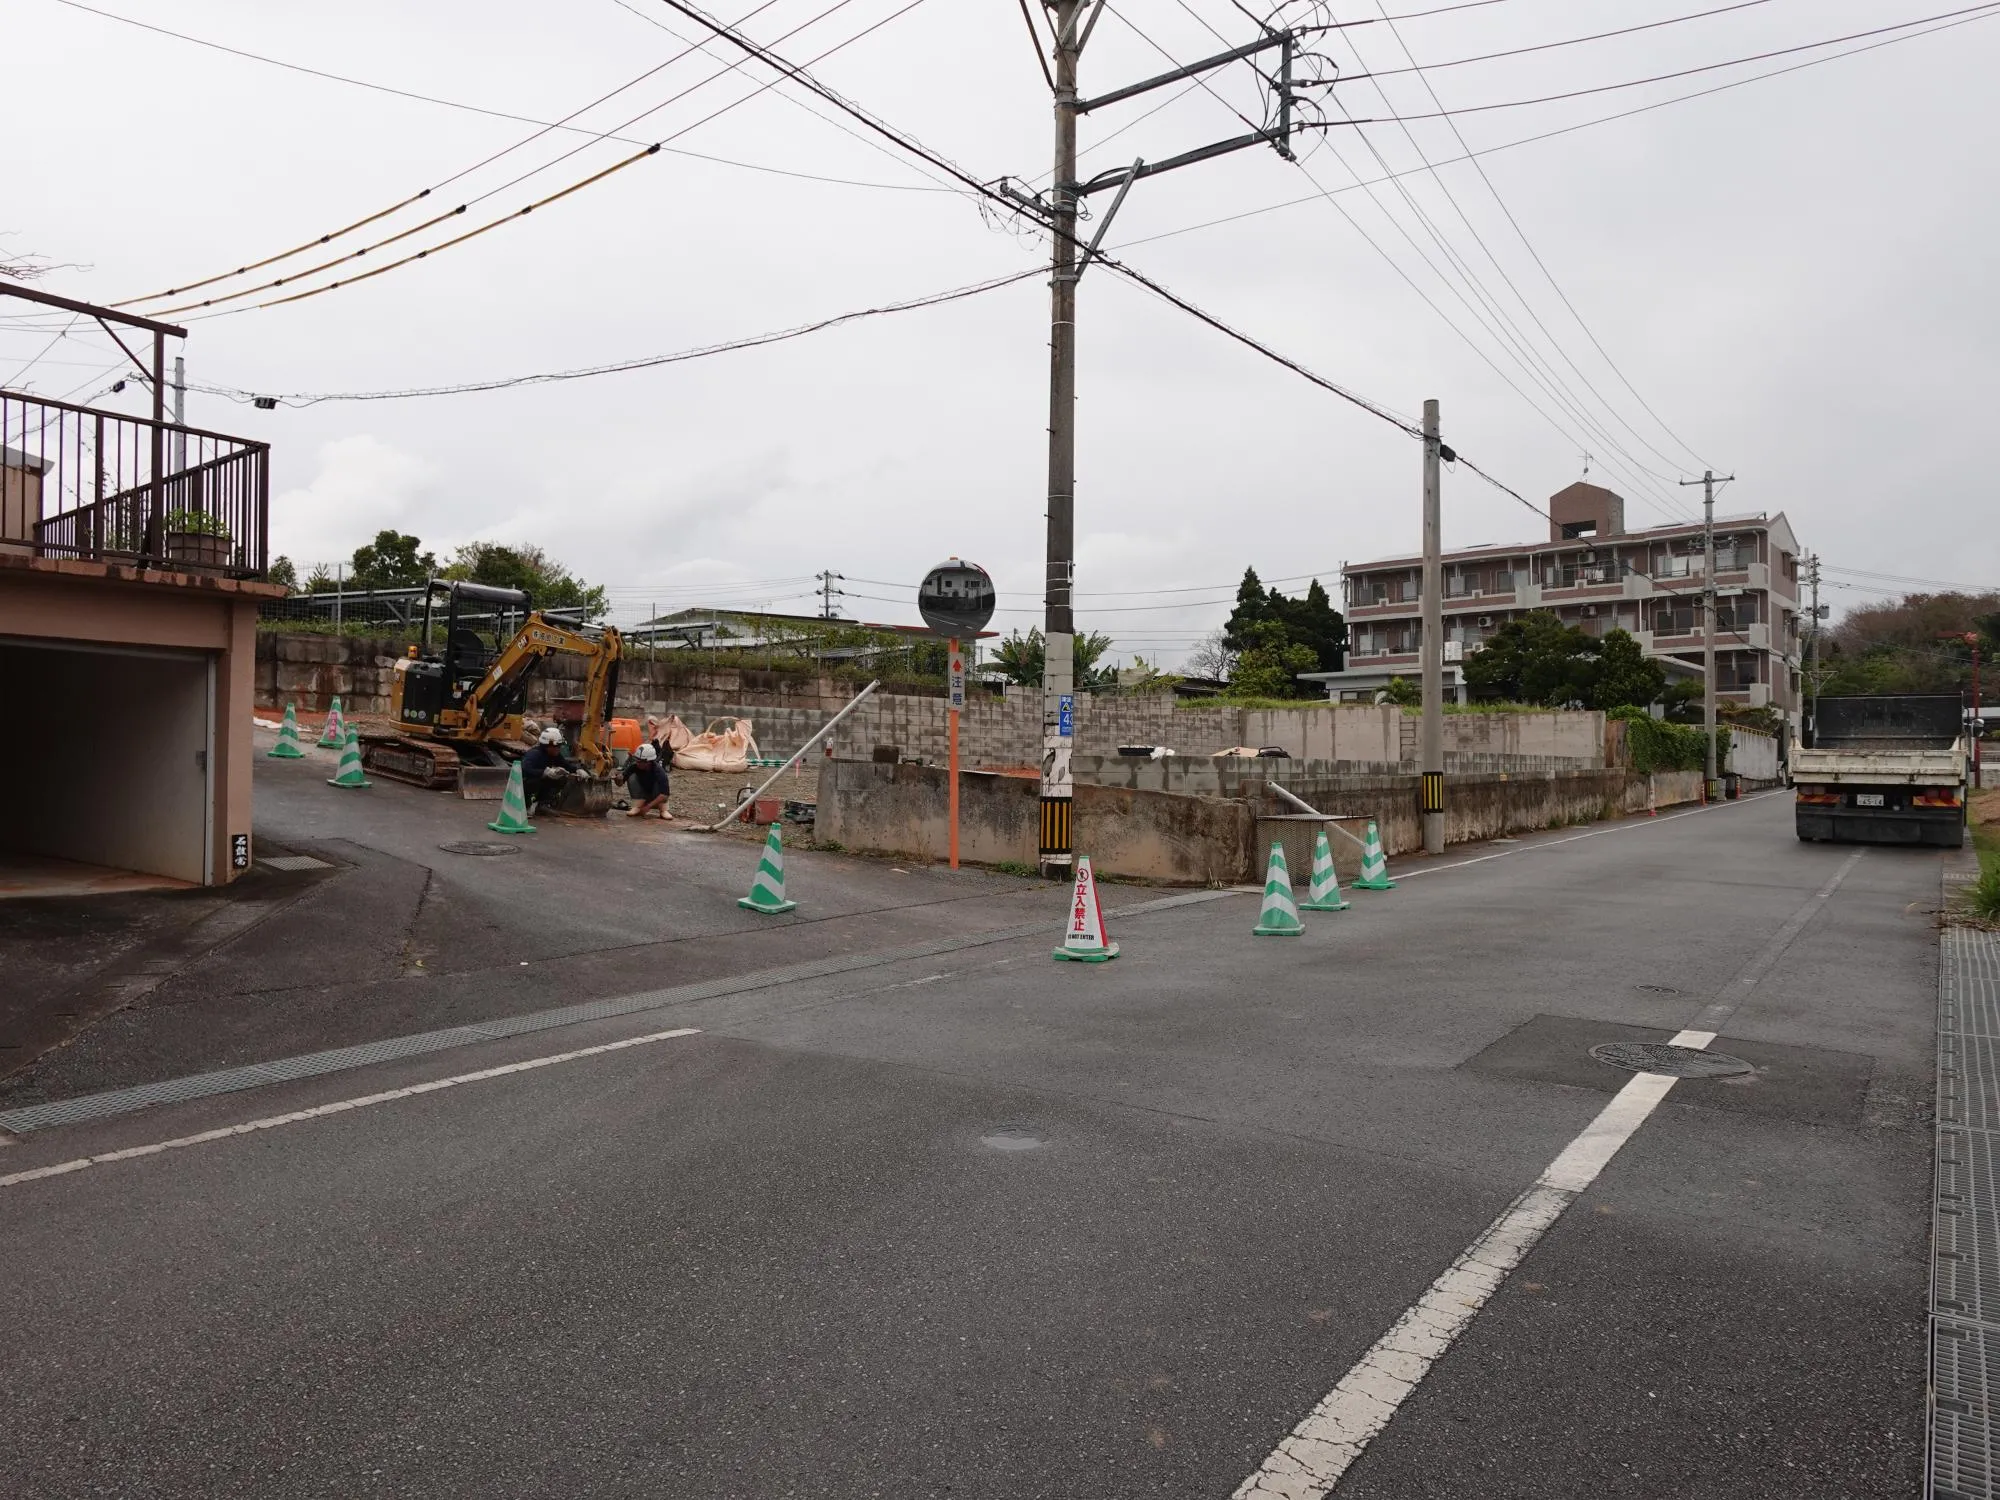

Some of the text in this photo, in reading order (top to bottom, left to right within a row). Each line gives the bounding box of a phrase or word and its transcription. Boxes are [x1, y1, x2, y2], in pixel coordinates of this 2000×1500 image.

[952, 675, 963, 706] 注意
[1074, 884, 1087, 931] 立入禁止
